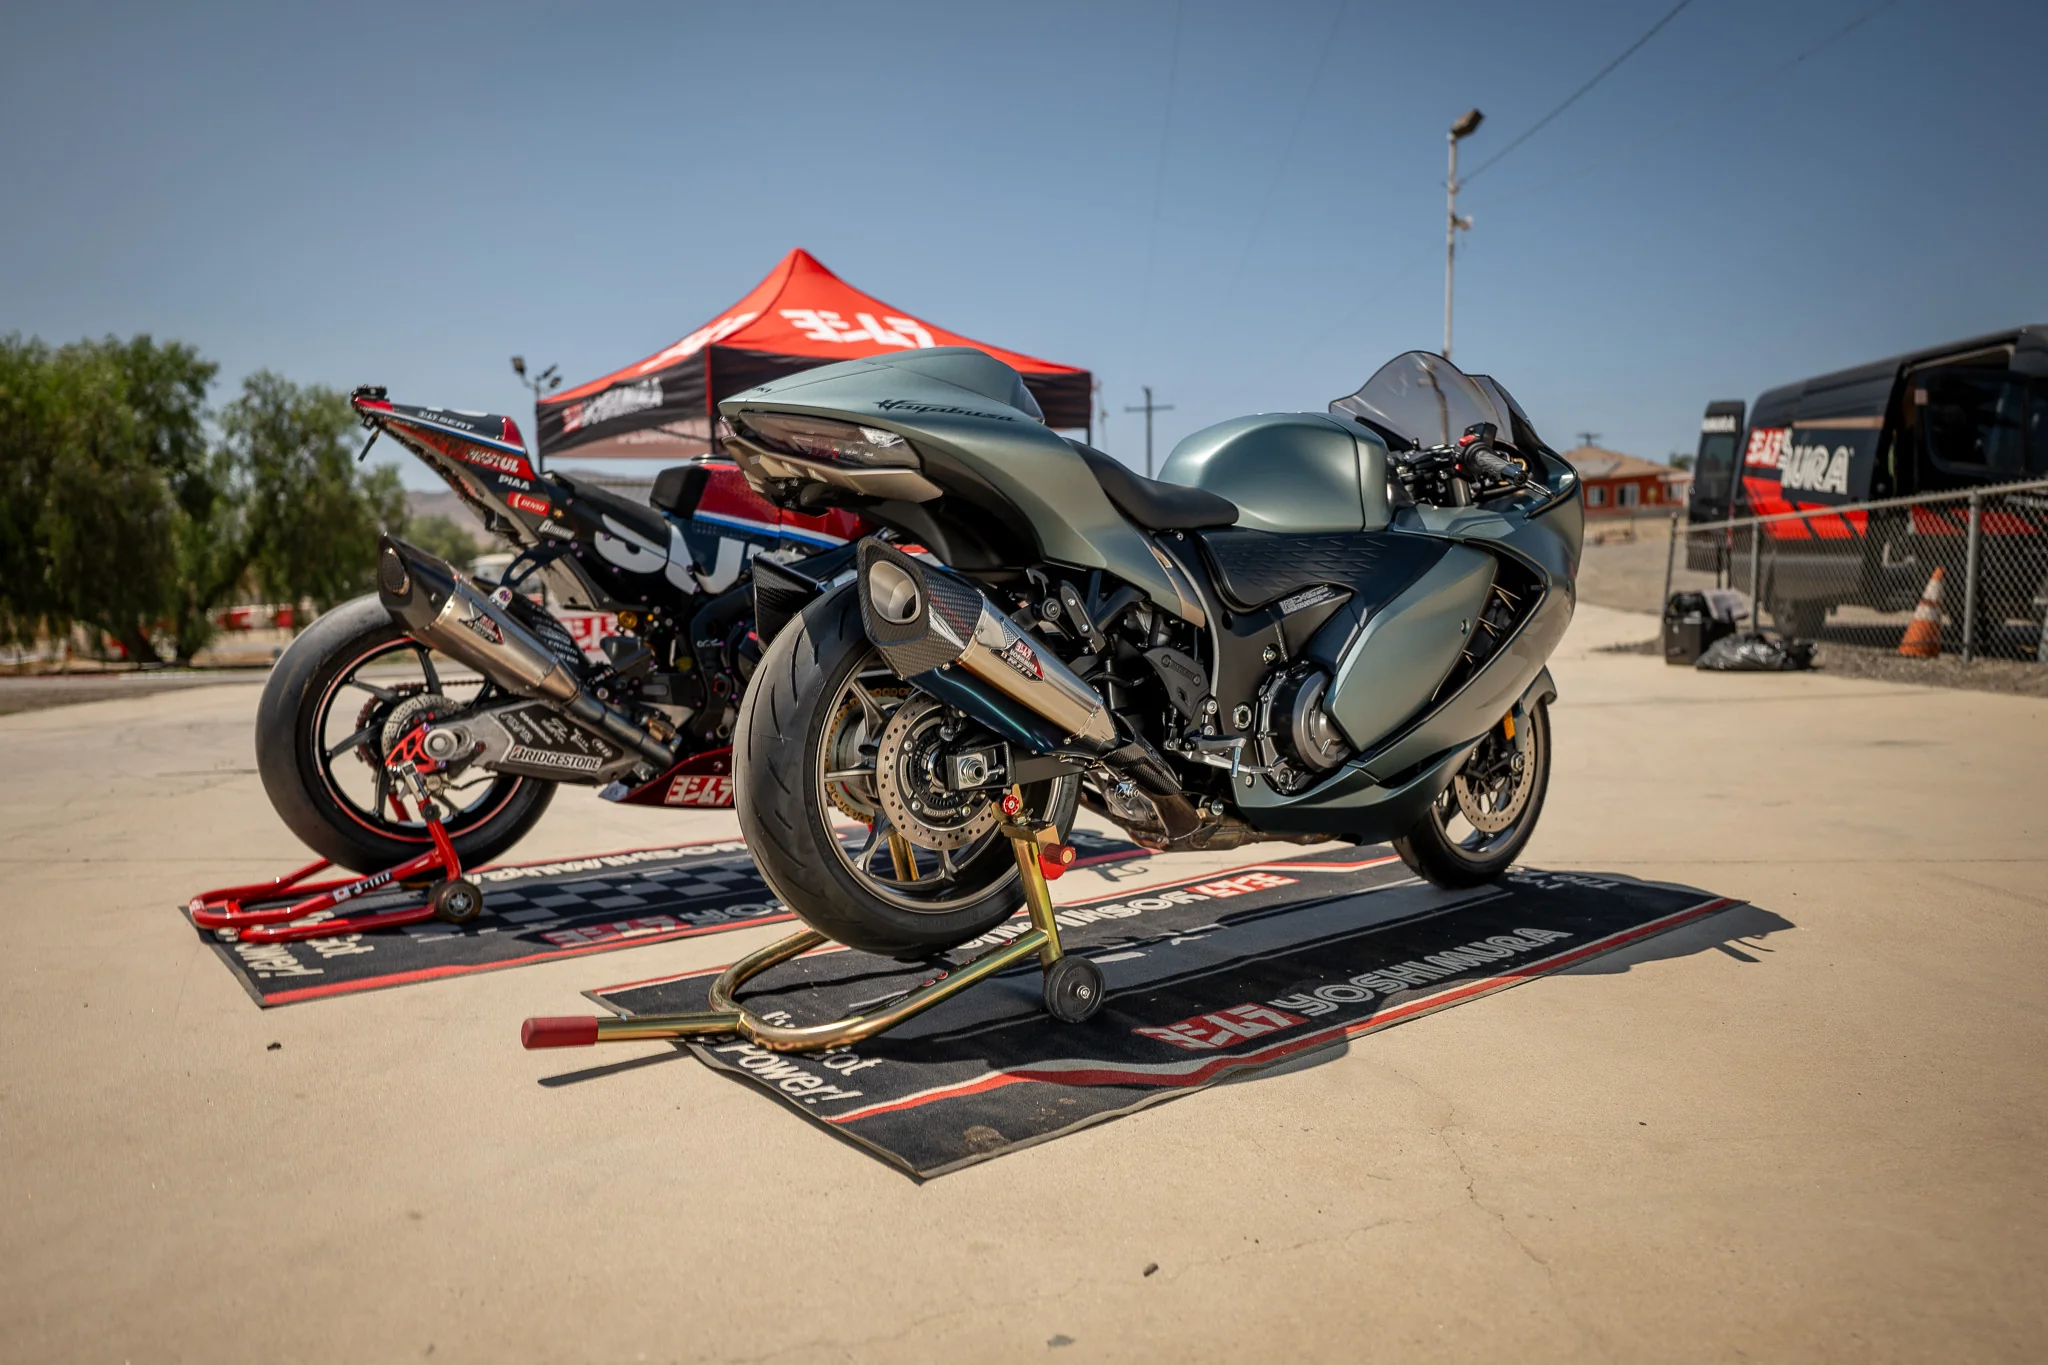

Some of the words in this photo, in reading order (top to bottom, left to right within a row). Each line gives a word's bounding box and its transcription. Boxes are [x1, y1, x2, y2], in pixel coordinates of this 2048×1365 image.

[873, 399, 1020, 422] Hayabusa
[498, 474, 530, 491] PIAA
[520, 498, 546, 512] DENSO
[510, 746, 601, 771] BRIDGESTONE
[1268, 928, 1573, 1016] YOSHIMURA
